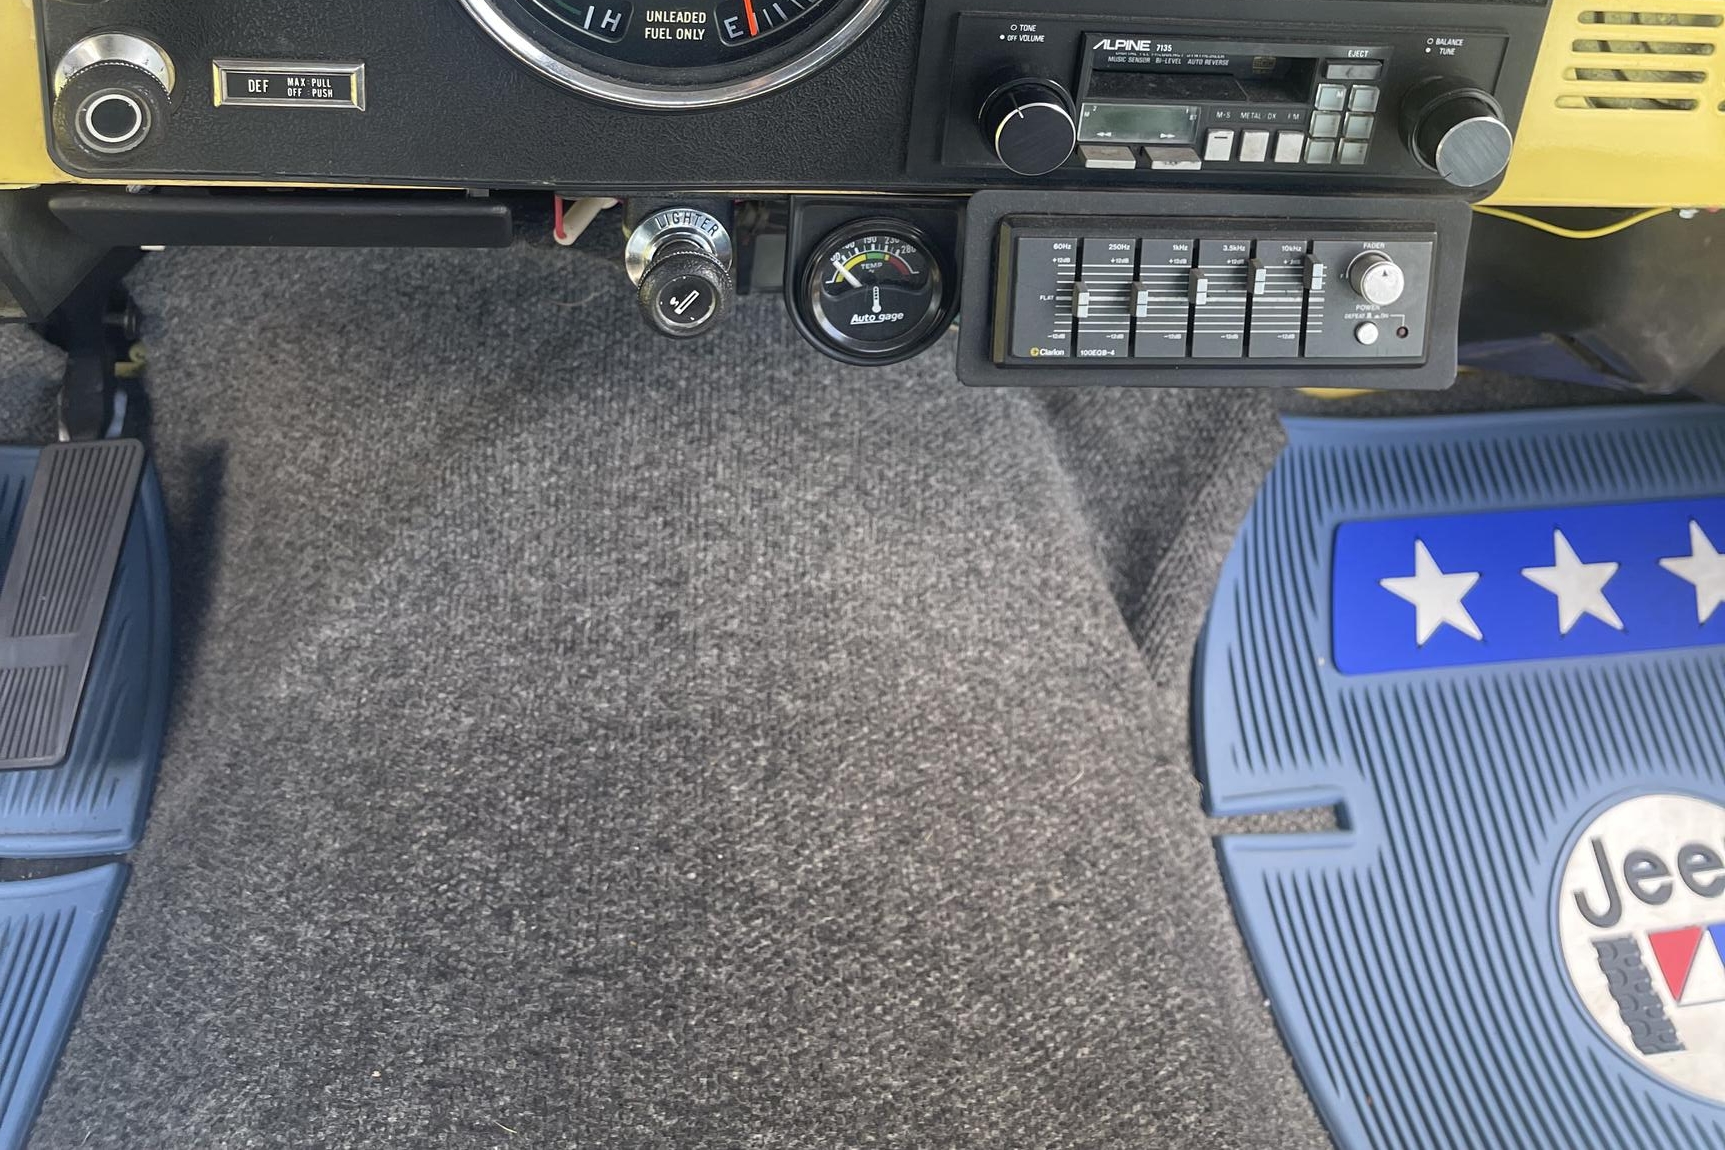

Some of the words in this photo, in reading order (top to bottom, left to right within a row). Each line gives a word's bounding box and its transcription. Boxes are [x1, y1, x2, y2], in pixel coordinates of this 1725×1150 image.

[600, 9, 622, 32] H
[646, 10, 706, 24] UNLEADED
[723, 16, 744, 39] E
[1020, 24, 1036, 32] TONE
[645, 28, 672, 40] FUEL
[675, 28, 705, 41] ONLY
[1019, 35, 1045, 43] VOLUME
[1093, 39, 1151, 51] ALPINE
[1156, 44, 1173, 52] 7135
[1435, 38, 1464, 46] BALANCE
[1348, 50, 1369, 58] EJECT
[1439, 47, 1455, 56] TUNE
[1155, 57, 1181, 65] BI-LEVEL
[248, 79, 269, 93] DEF
[1240, 112, 1261, 120] METAL
[654, 211, 720, 237] LIGHTER
[850, 314, 876, 324] Auto
[878, 312, 904, 322] gage
[1573, 836, 1725, 929] Jee
